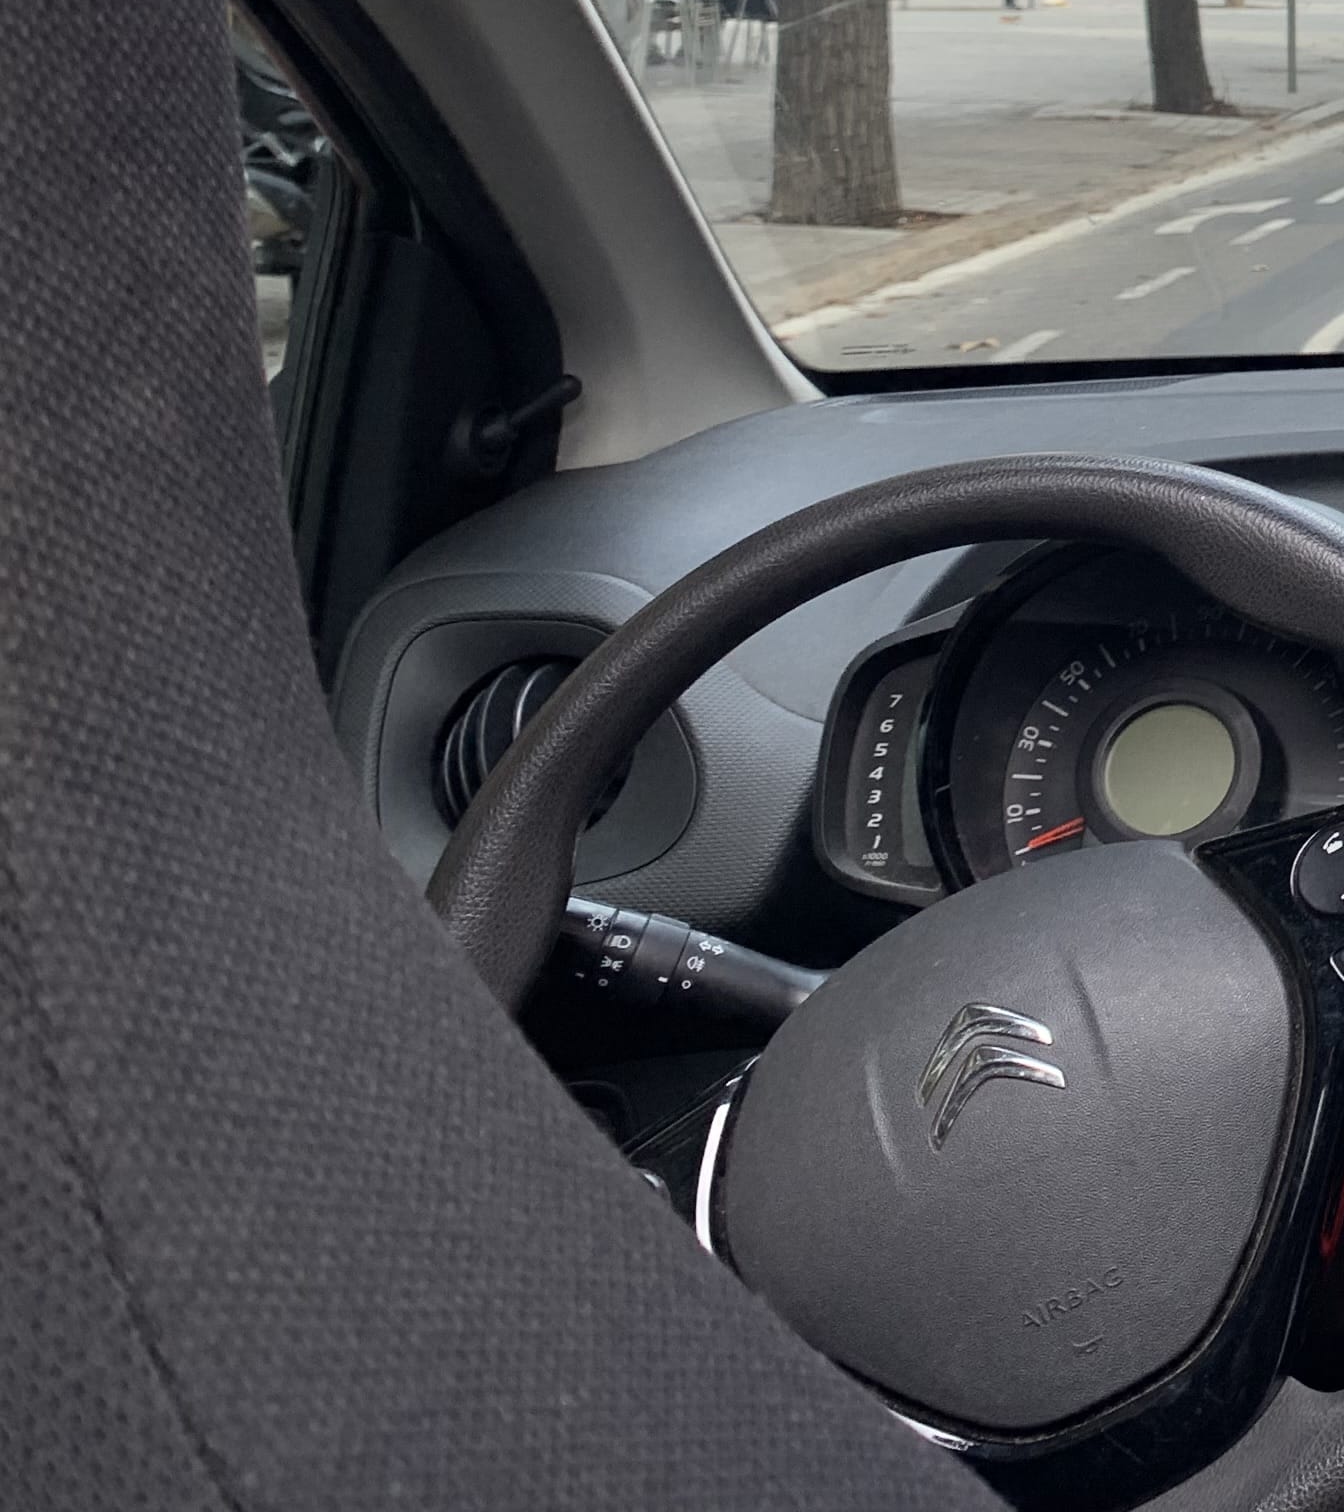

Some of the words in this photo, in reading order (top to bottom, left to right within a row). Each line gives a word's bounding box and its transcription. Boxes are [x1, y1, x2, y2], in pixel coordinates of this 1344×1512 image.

[1059, 660, 1085, 686] 50
[889, 694, 903, 708] 7
[880, 719, 895, 733] 6
[1018, 726, 1040, 752] 30
[873, 743, 889, 757] 5
[868, 766, 884, 780] 4
[867, 789, 882, 804] 3
[867, 813, 883, 828] 2
[1006, 803, 1024, 824] 10
[872, 835, 881, 849] 1
[1022, 1265, 1124, 1328] AIRBAG
